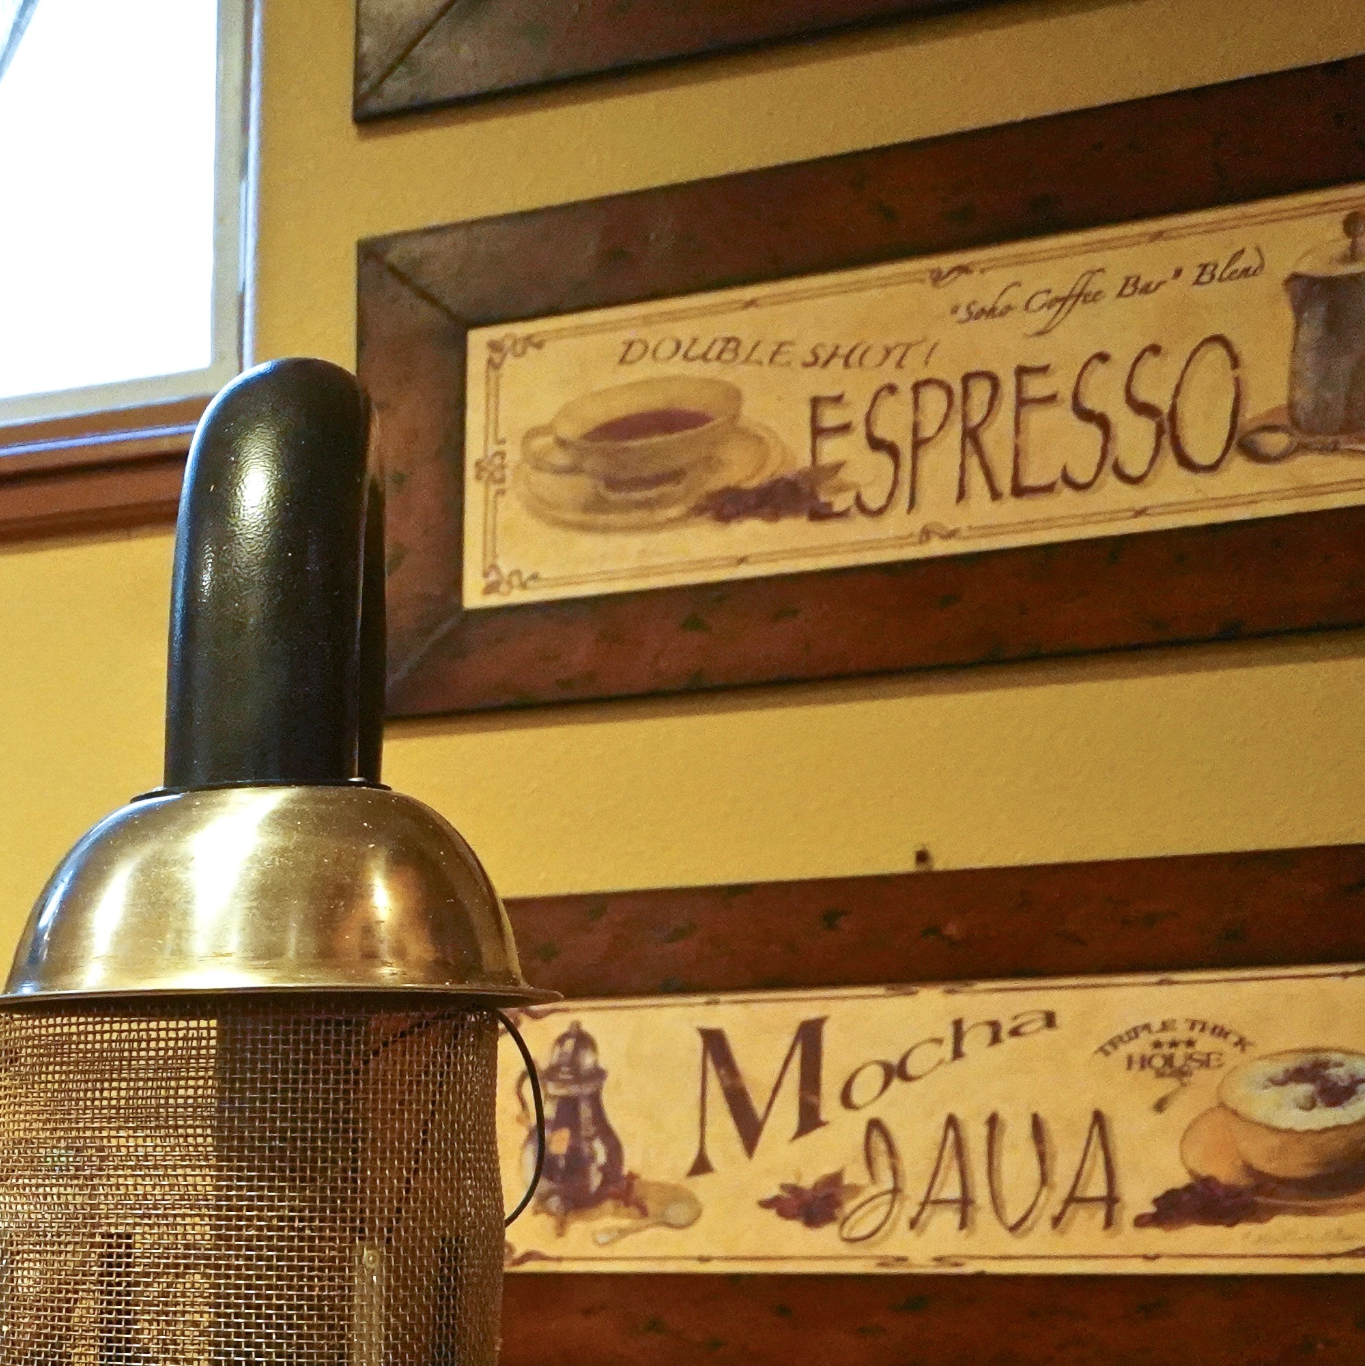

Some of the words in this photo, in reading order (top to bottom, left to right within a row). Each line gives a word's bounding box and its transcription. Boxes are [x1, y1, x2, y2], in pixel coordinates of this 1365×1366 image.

[1024, 267, 1106, 338] Coffee
[1192, 245, 1265, 287] Blend
[618, 336, 796, 367] DOUBLE
[807, 334, 1244, 521] ESPRESSO
[686, 1008, 1057, 1178] Mocha
[1126, 1051, 1224, 1072] HOUSE
